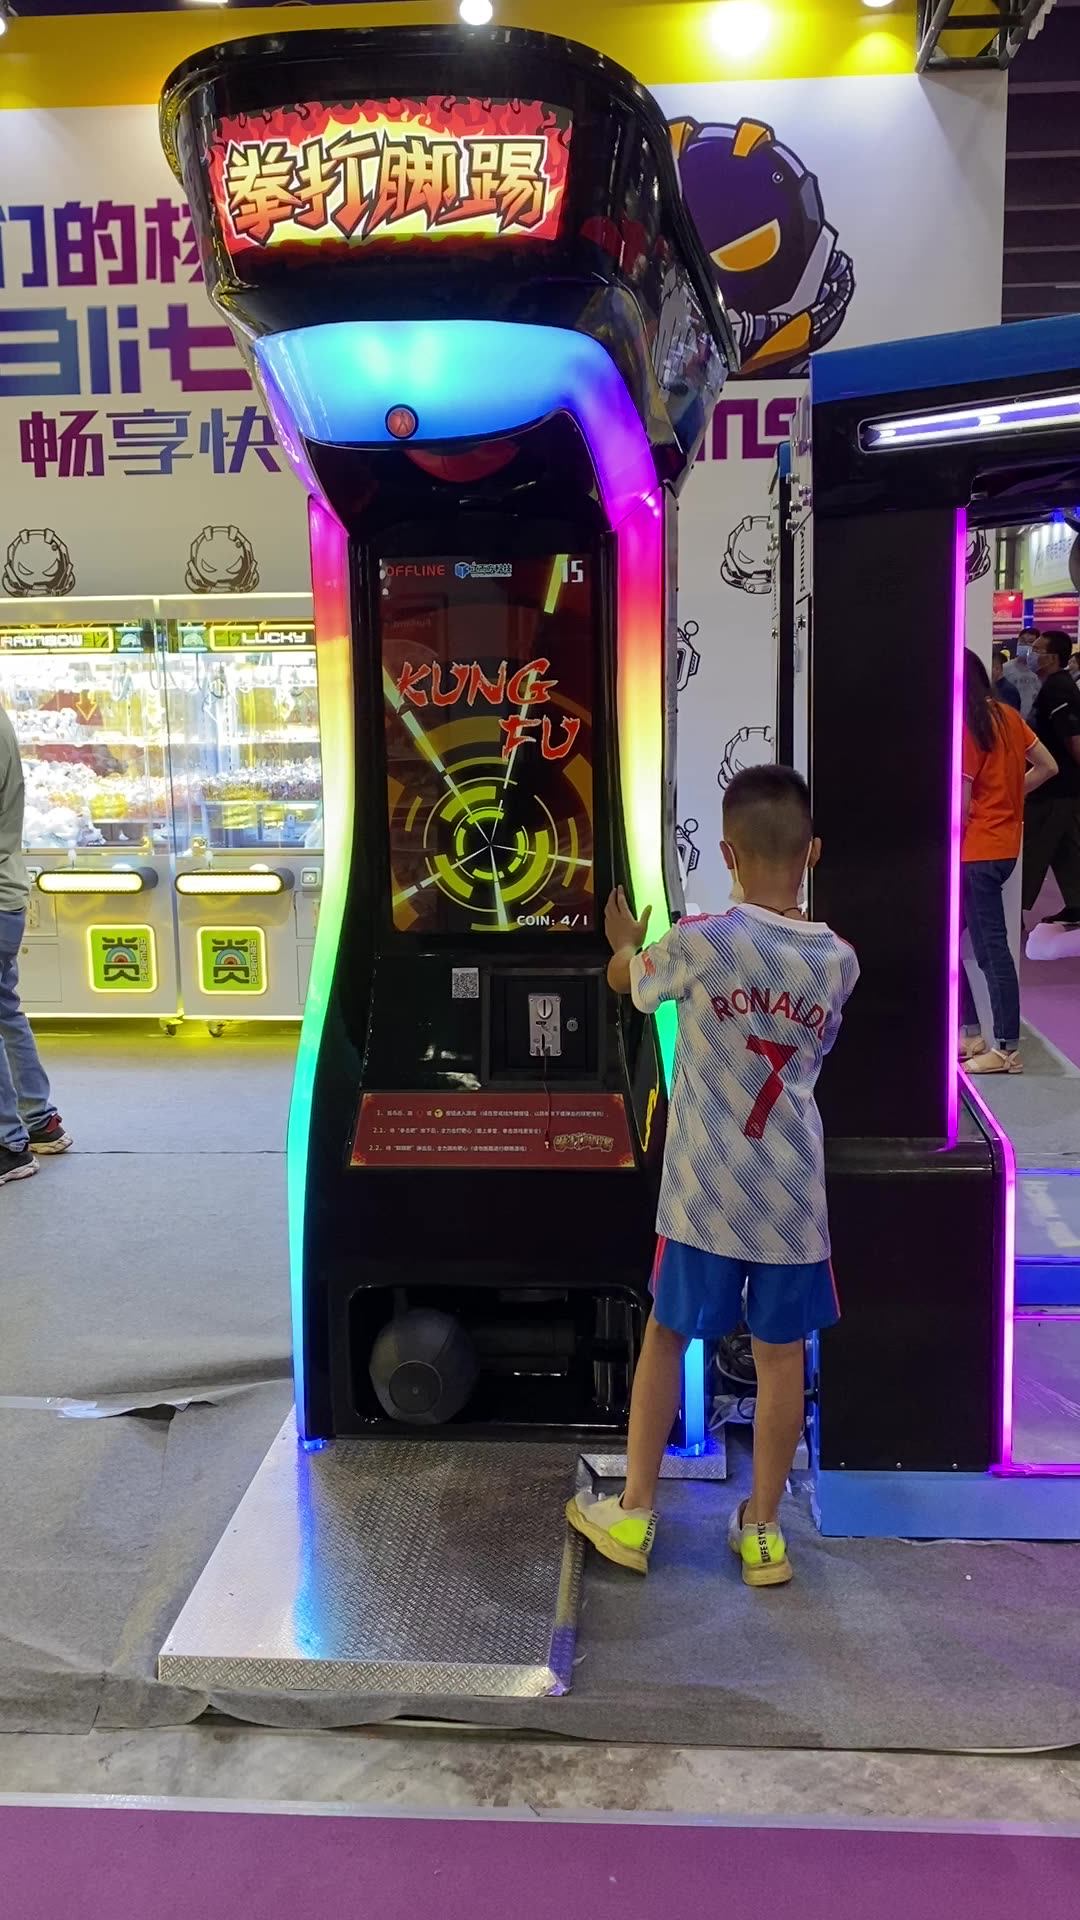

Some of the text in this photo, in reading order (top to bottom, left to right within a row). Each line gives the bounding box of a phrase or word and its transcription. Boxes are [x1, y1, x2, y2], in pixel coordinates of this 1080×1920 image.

[224, 132, 549, 243] 拳打脚踢
[19, 406, 282, 478] 畅享快
[386, 564, 446, 577] OFFLINE
[561, 560, 584, 583] 15
[1, 634, 83, 648] RAINBOW
[241, 631, 306, 644] LUCKY
[396, 657, 559, 707] KUNG
[498, 714, 580, 760] FU
[517, 915, 555, 926] COIN:
[744, 1034, 799, 1140] 7
